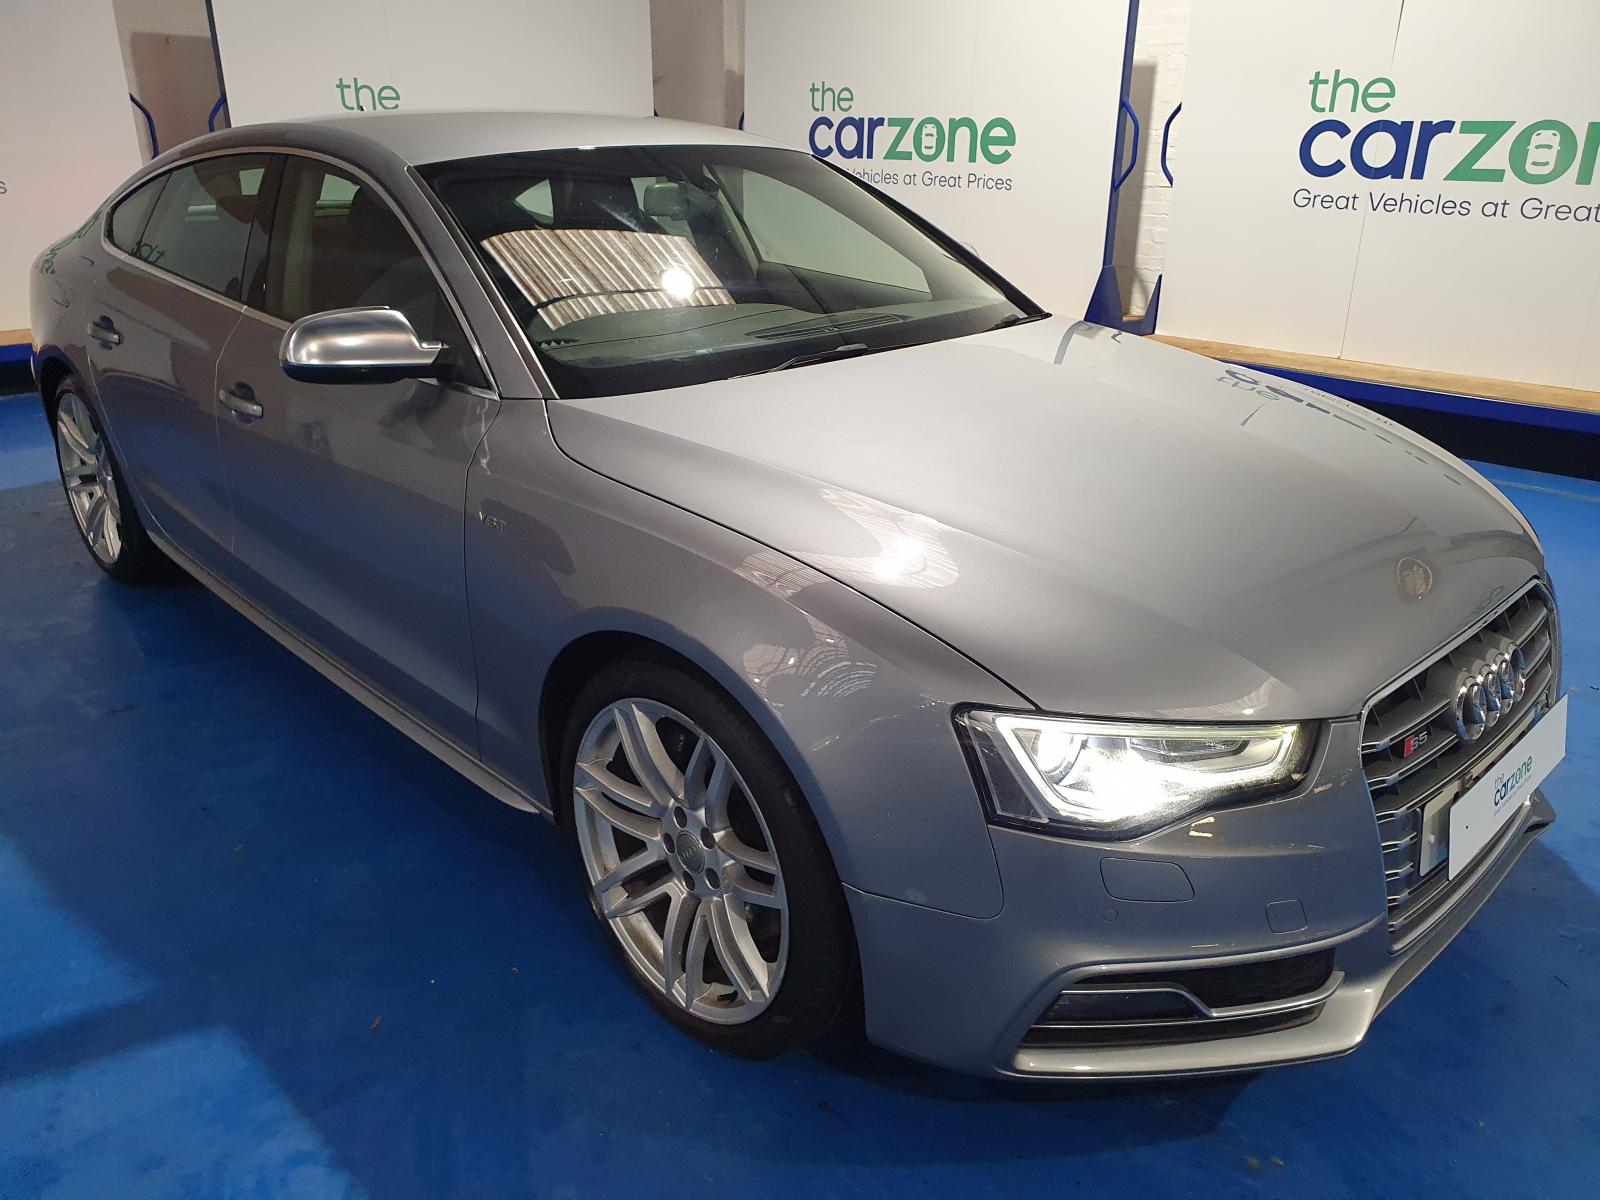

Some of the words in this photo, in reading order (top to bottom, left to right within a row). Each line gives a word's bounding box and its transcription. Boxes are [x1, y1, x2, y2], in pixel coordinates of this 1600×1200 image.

[336, 77, 400, 111] the
[809, 80, 854, 112] the
[1308, 69, 1396, 113] the
[808, 116, 1017, 165] carzone
[903, 172, 917, 186] at
[921, 170, 962, 188] Great
[967, 173, 1013, 191] Prices
[1293, 188, 1359, 211] Great
[1369, 191, 1472, 216] Vehicles
[1481, 199, 1510, 218] at
[1494, 755, 1533, 807] carzone
